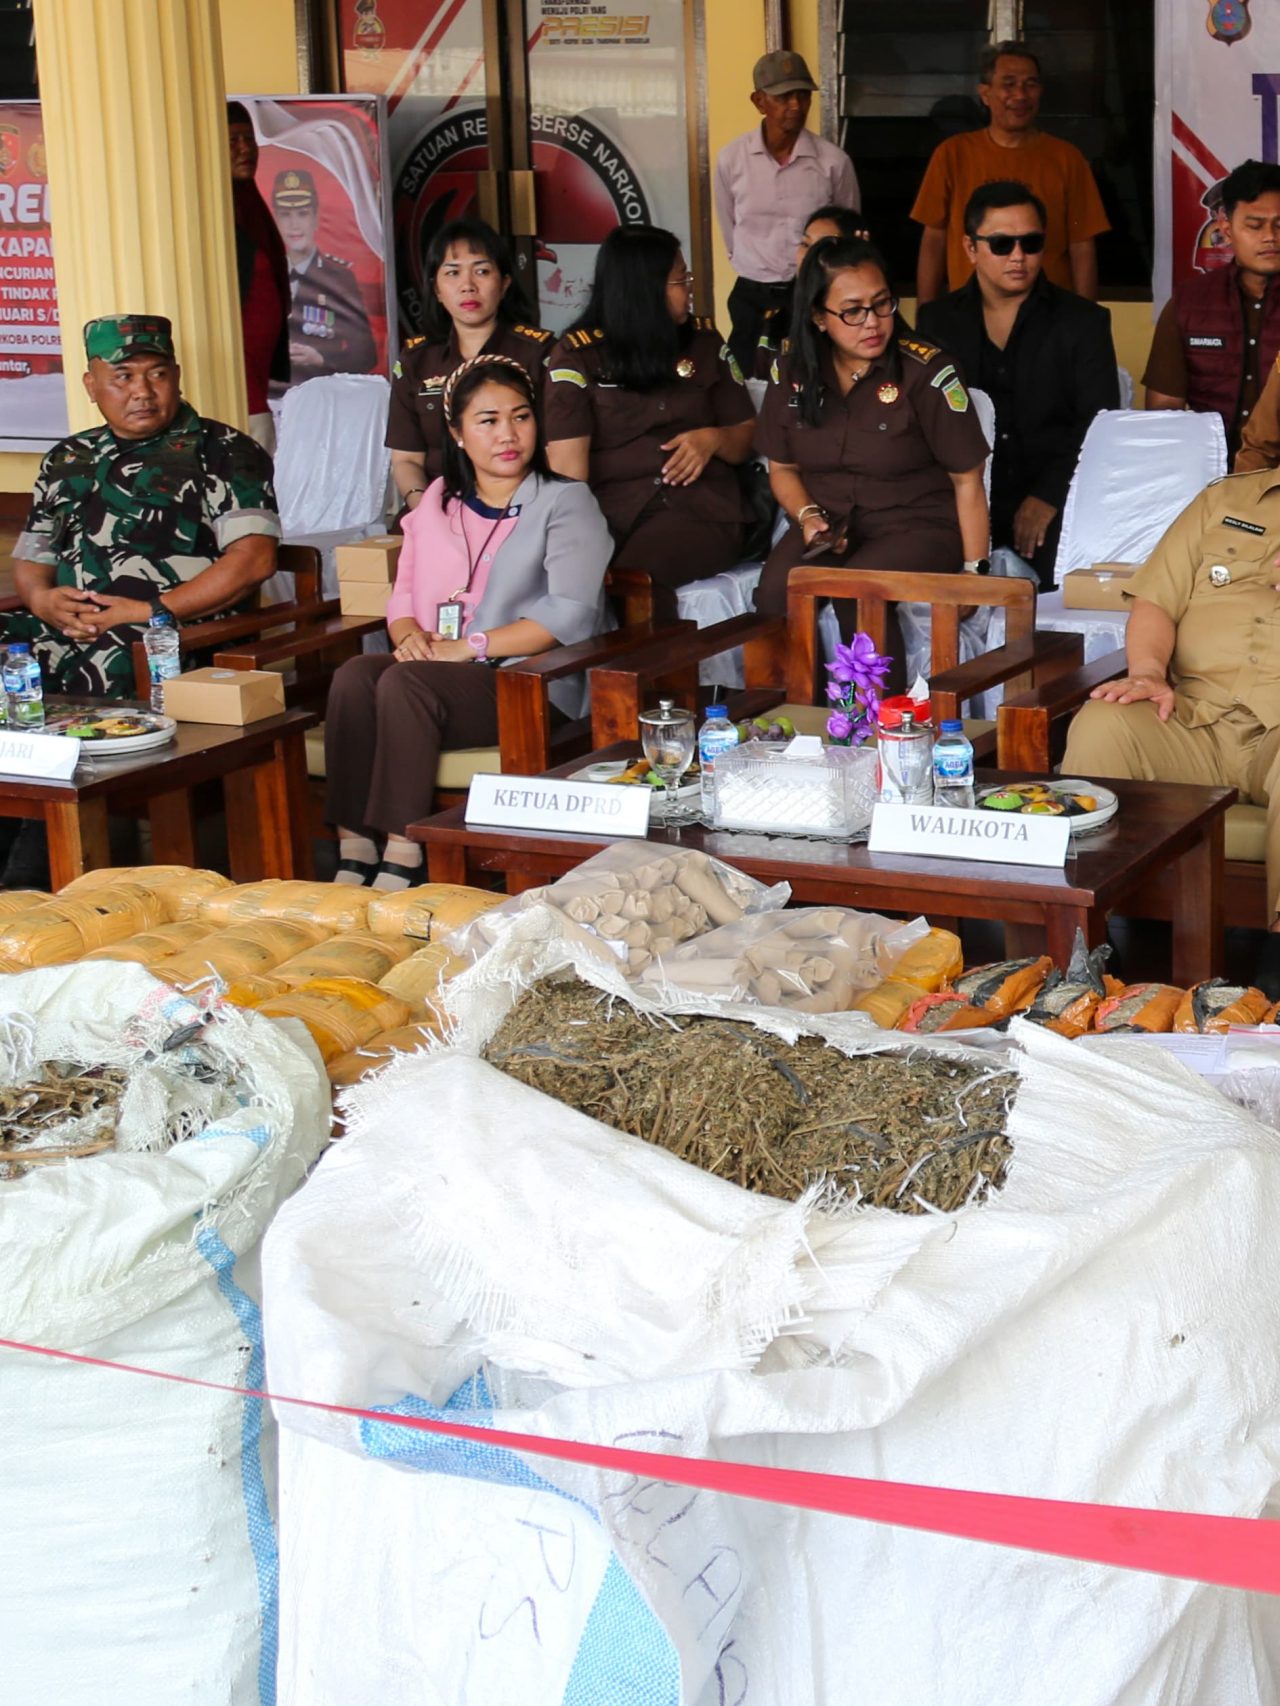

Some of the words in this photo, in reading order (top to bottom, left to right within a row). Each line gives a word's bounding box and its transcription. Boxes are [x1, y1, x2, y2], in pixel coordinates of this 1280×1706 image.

[544, 16, 650, 36] PRESISI
[402, 125, 459, 193] SATUAN
[593, 142, 644, 225] NARKO
[2, 286, 50, 305] TINDAK
[494, 789, 559, 811] KETUA
[566, 793, 622, 816] DPRD
[910, 814, 1029, 841] WALIKOTA
